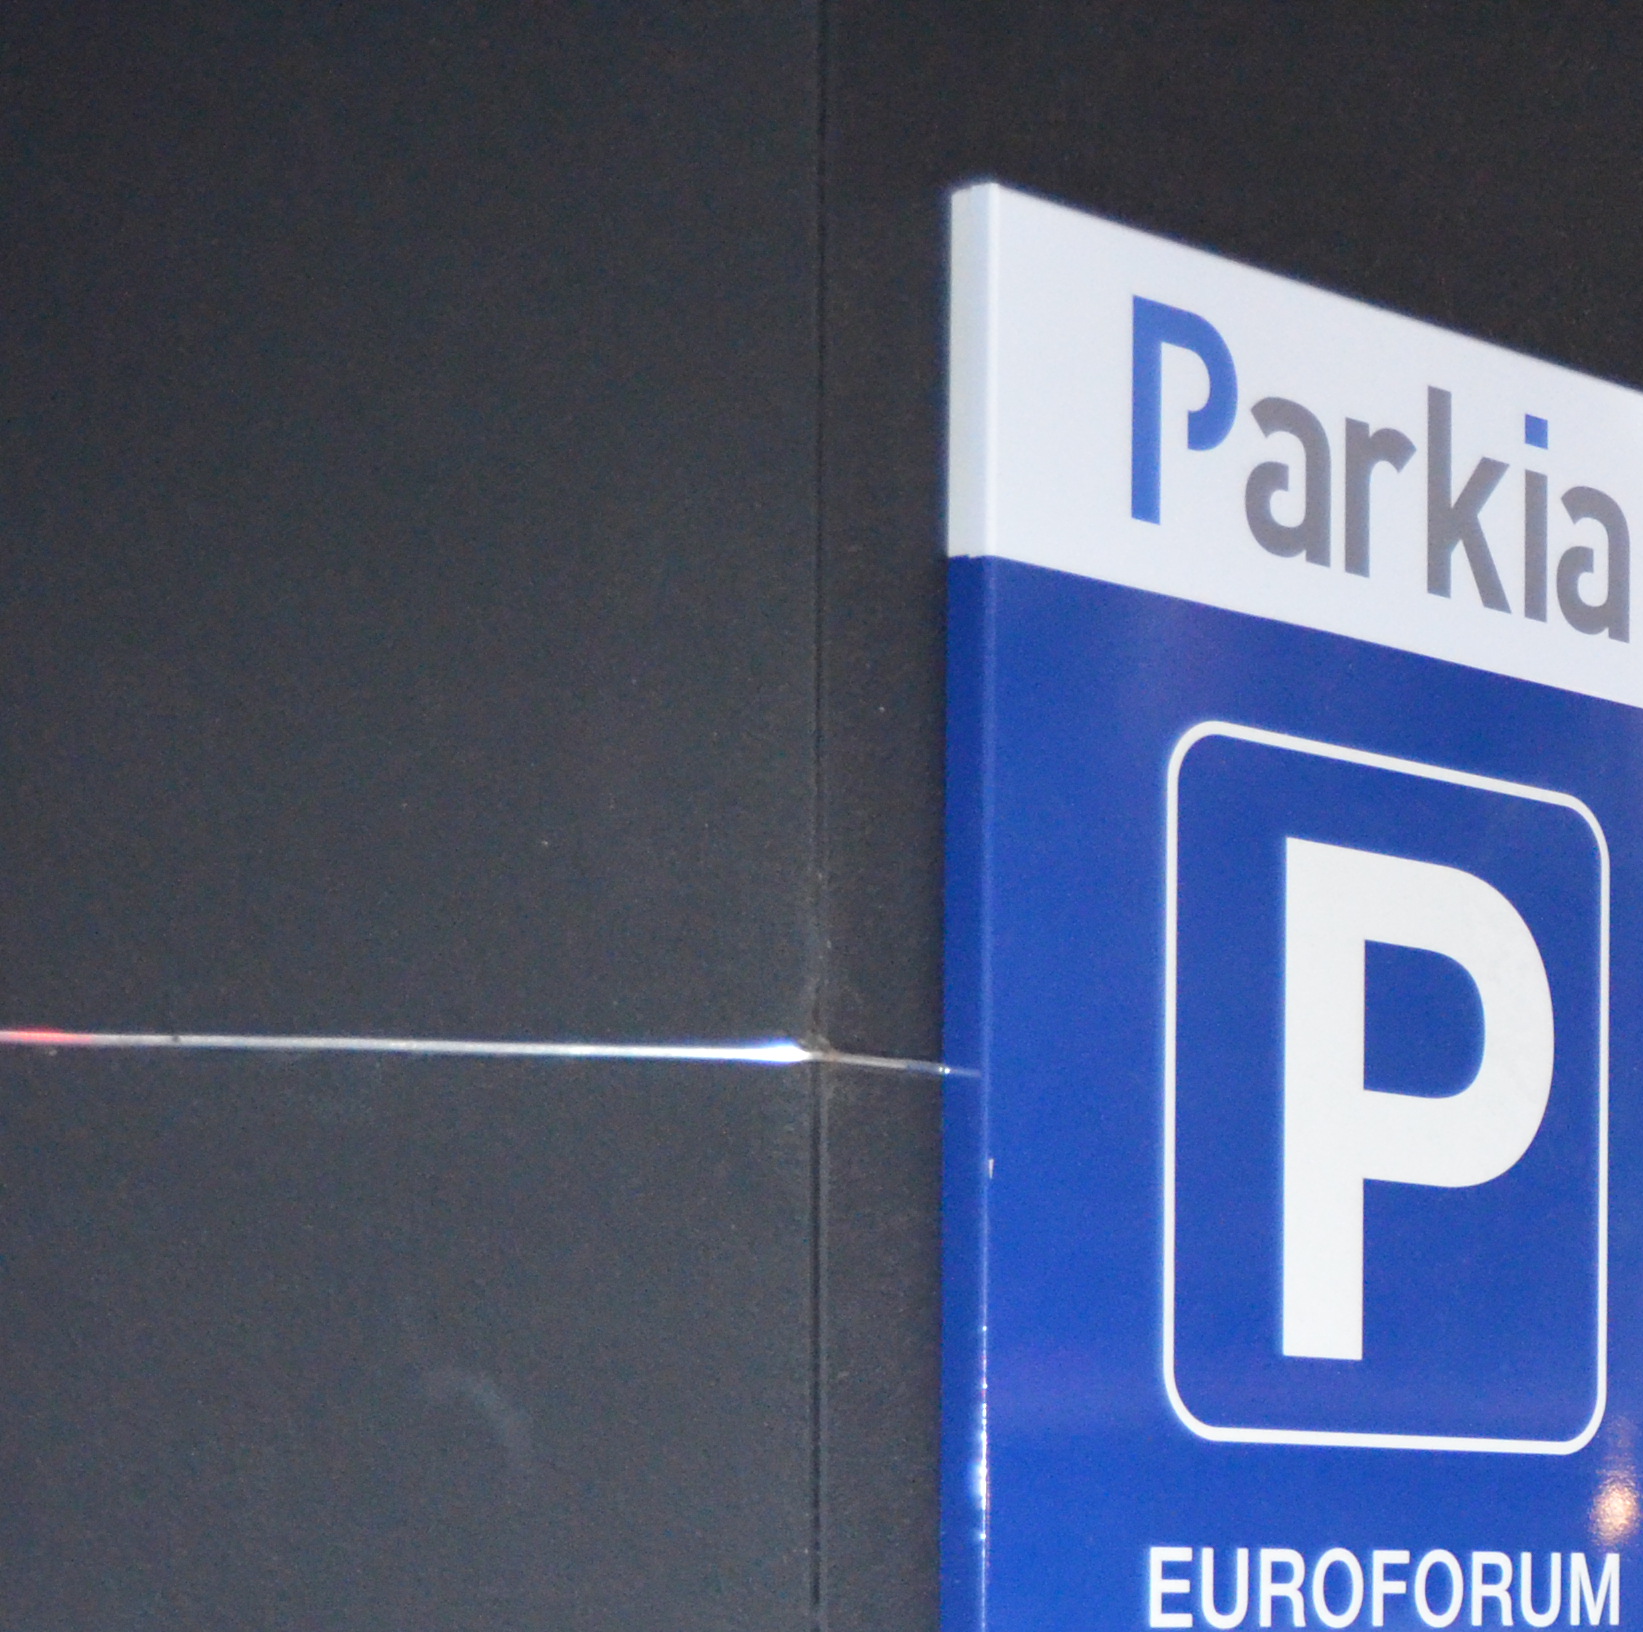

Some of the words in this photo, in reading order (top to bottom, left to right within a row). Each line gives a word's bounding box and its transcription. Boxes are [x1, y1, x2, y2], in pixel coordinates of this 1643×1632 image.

[1131, 295, 1632, 643] Parkia
[1279, 836, 1555, 1362] P
[1147, 1545, 1624, 1632] EUROFORUM
